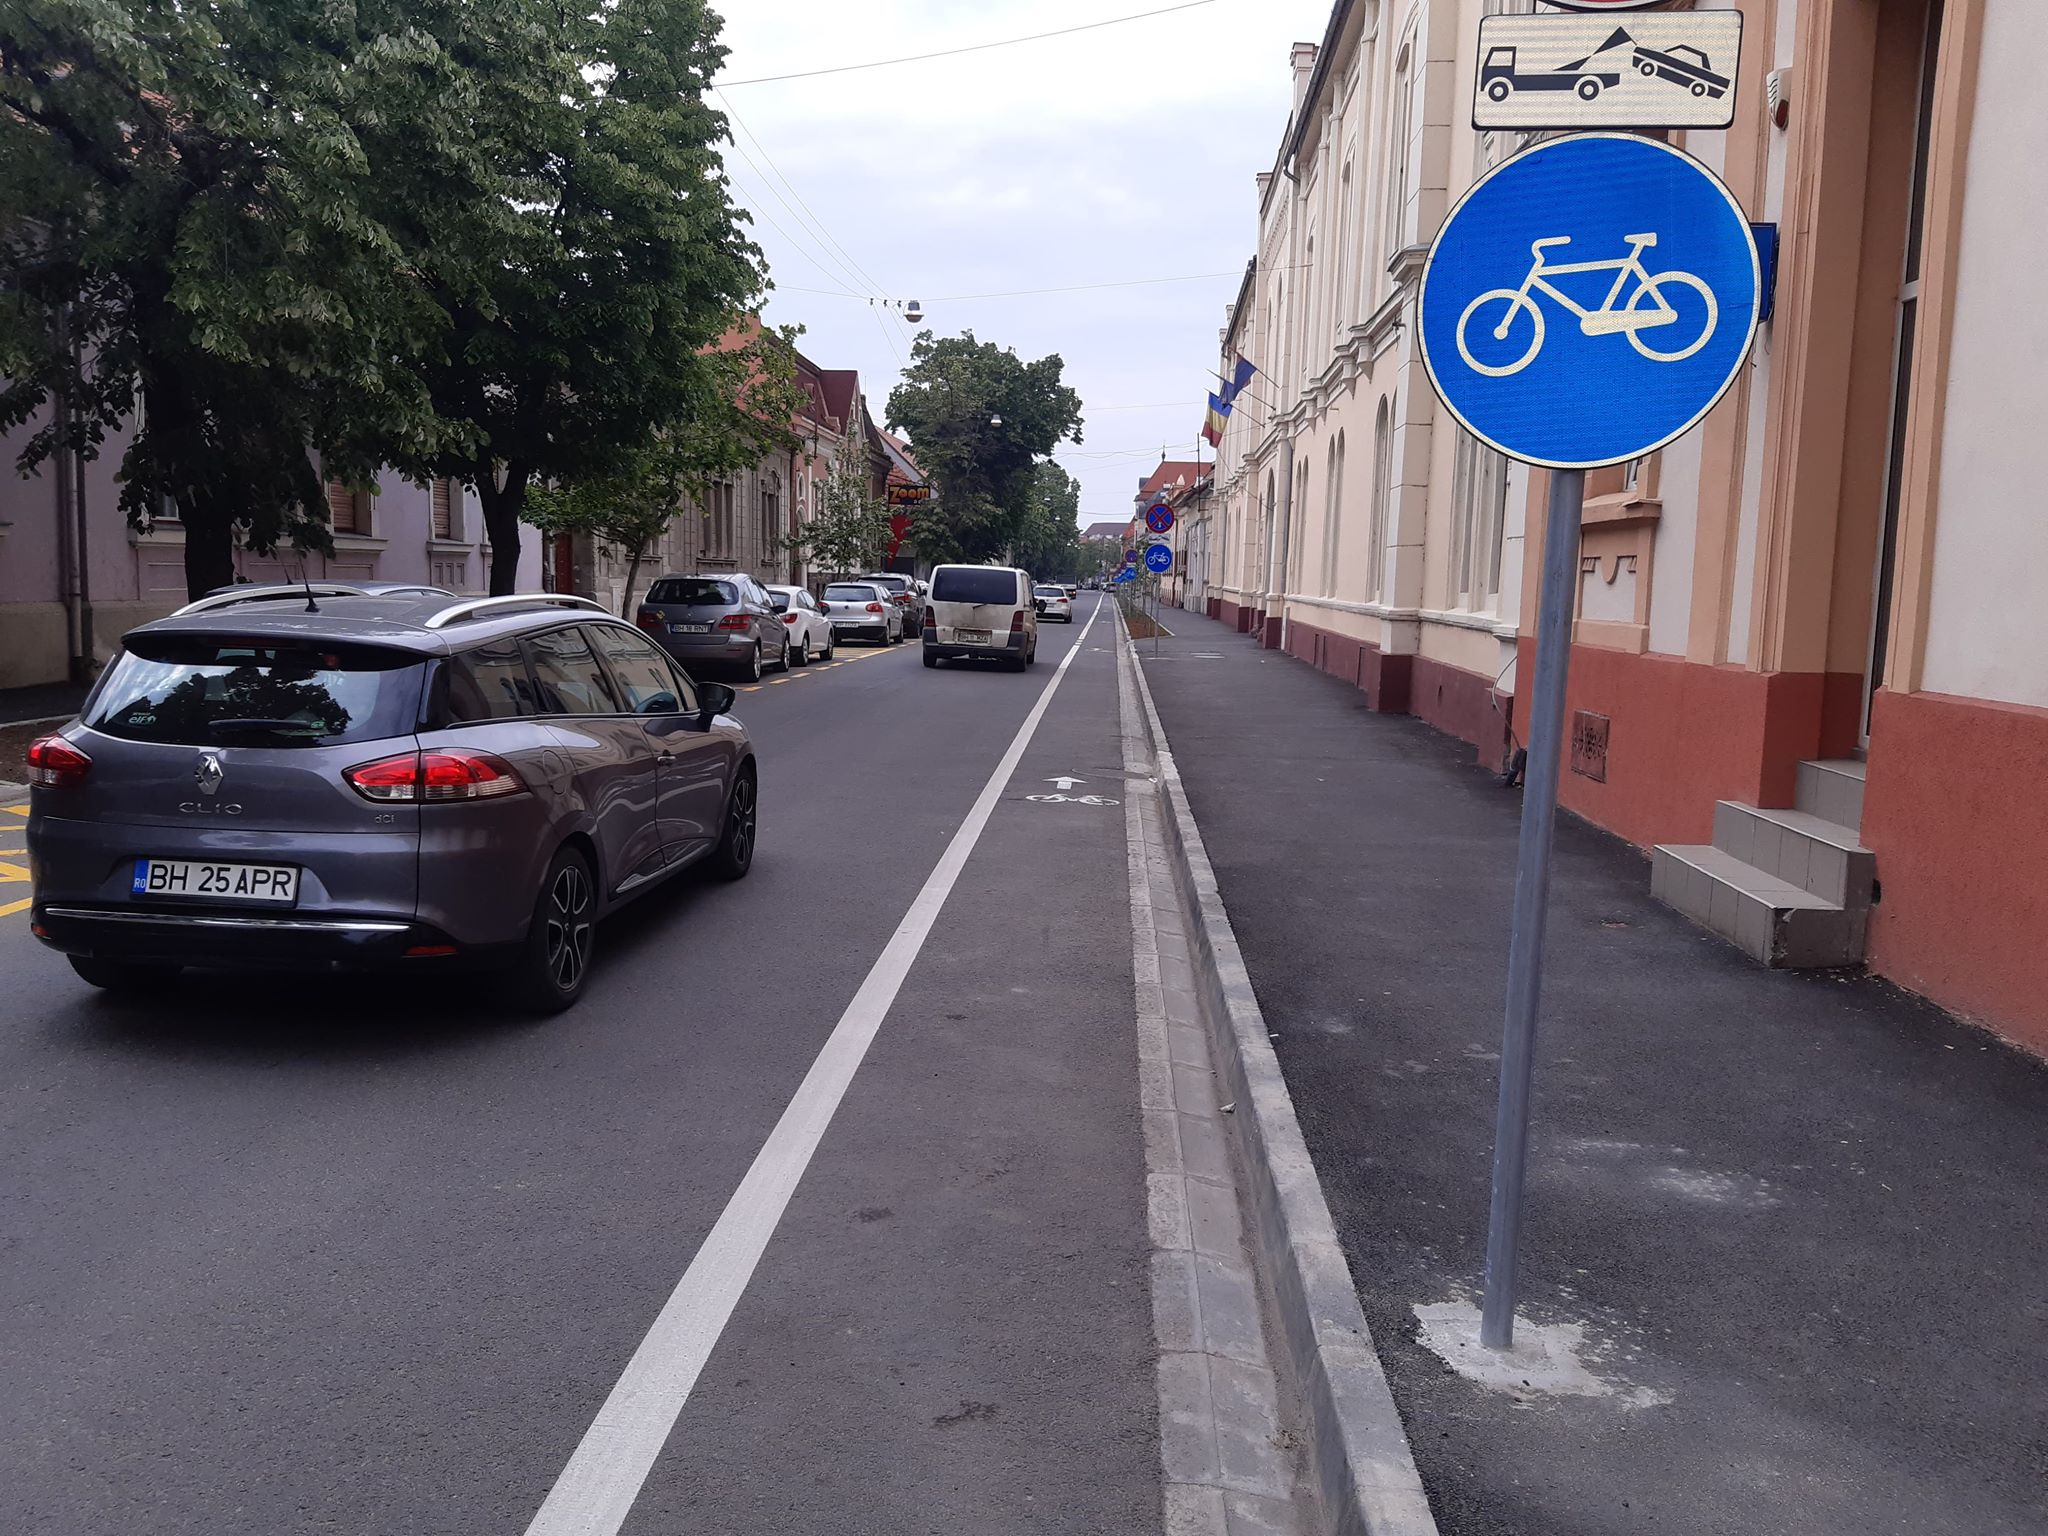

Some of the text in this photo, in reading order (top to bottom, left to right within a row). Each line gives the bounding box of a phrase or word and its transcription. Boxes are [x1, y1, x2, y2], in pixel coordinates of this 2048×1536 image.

[134, 878, 146, 888] RO
[149, 864, 291, 897] BH 25 APR
